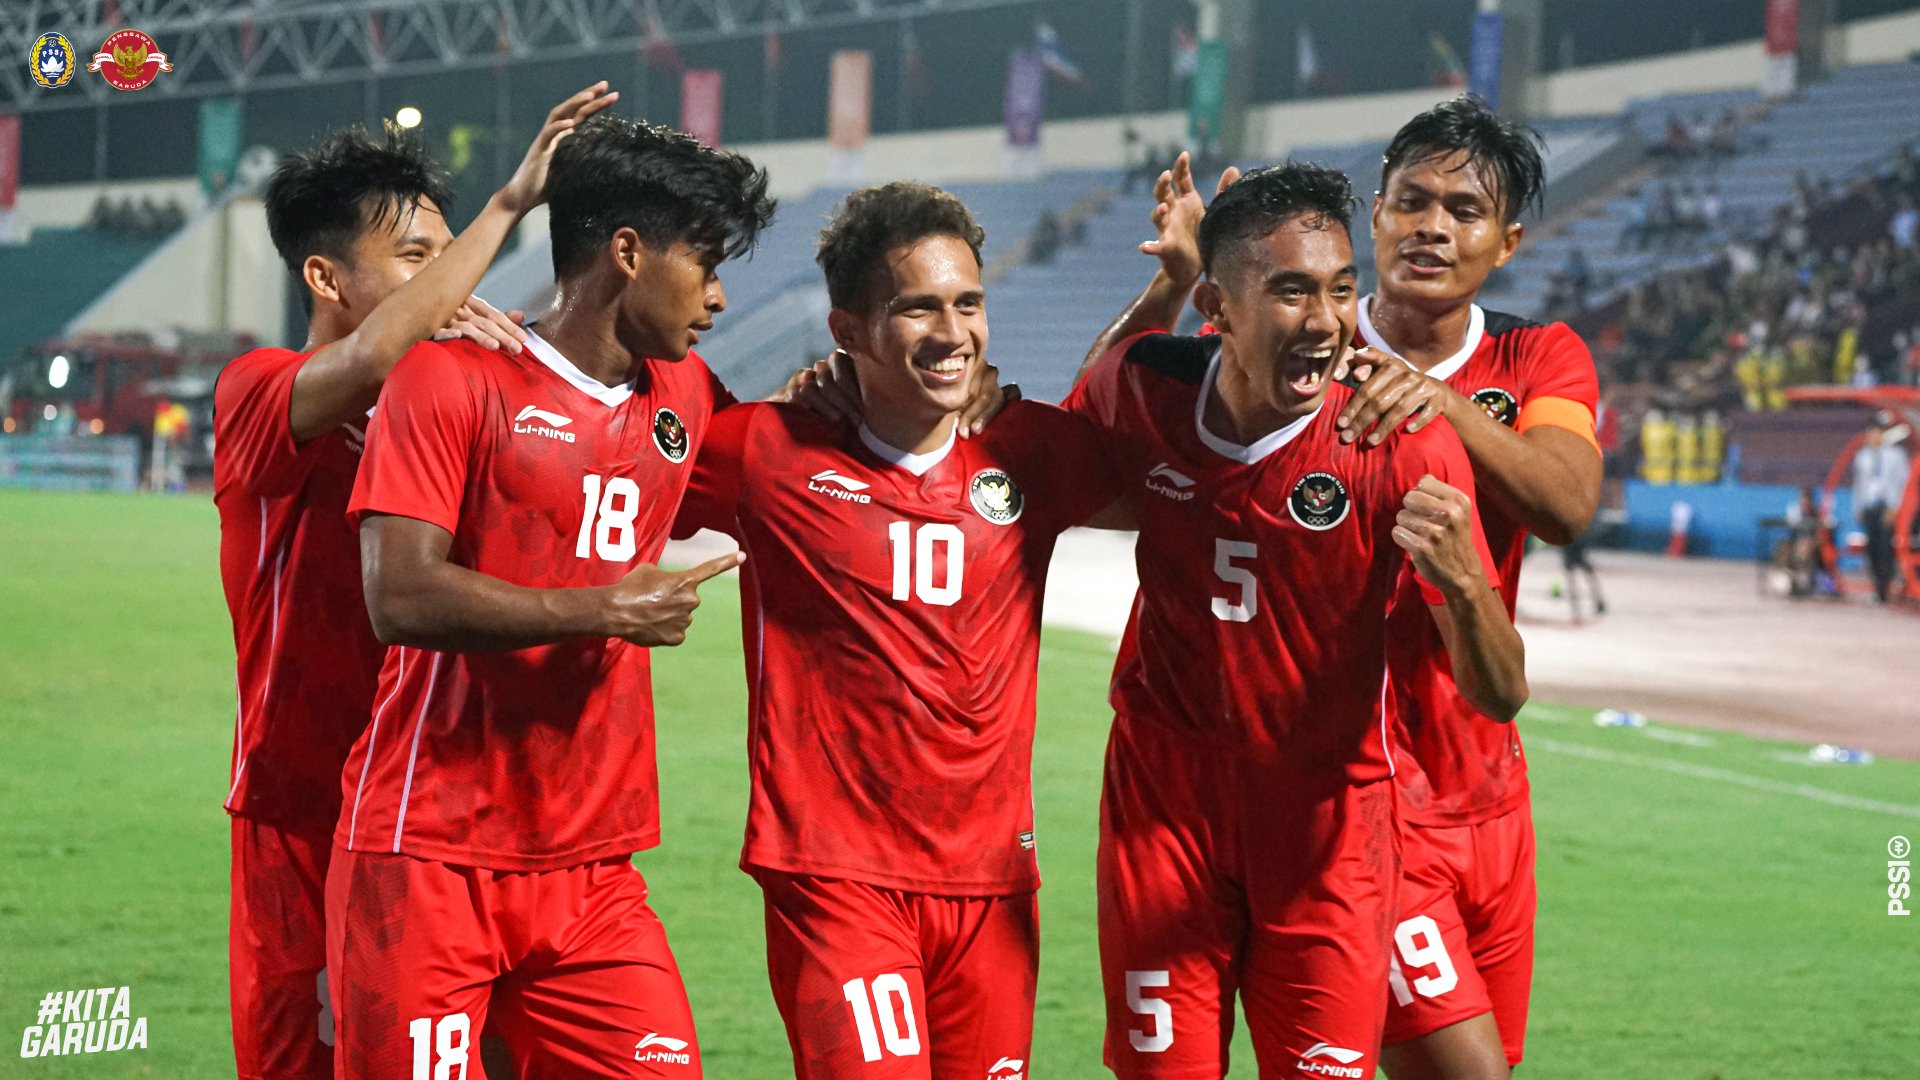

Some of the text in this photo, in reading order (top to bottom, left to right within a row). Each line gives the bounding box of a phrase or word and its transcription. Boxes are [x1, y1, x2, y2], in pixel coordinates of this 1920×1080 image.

[513, 422, 576, 444] LI-NING
[576, 474, 640, 562] 18
[808, 480, 872, 505] LI-NING
[1145, 478, 1196, 502] LI-NING
[889, 521, 965, 607] 10
[1211, 538, 1258, 623] 5
[842, 973, 921, 1063] 10
[1125, 970, 1174, 1053] 5
[409, 1012, 471, 1080] 18
[634, 1050, 690, 1065] LI-NING
[1296, 1060, 1364, 1079] LI-NING
